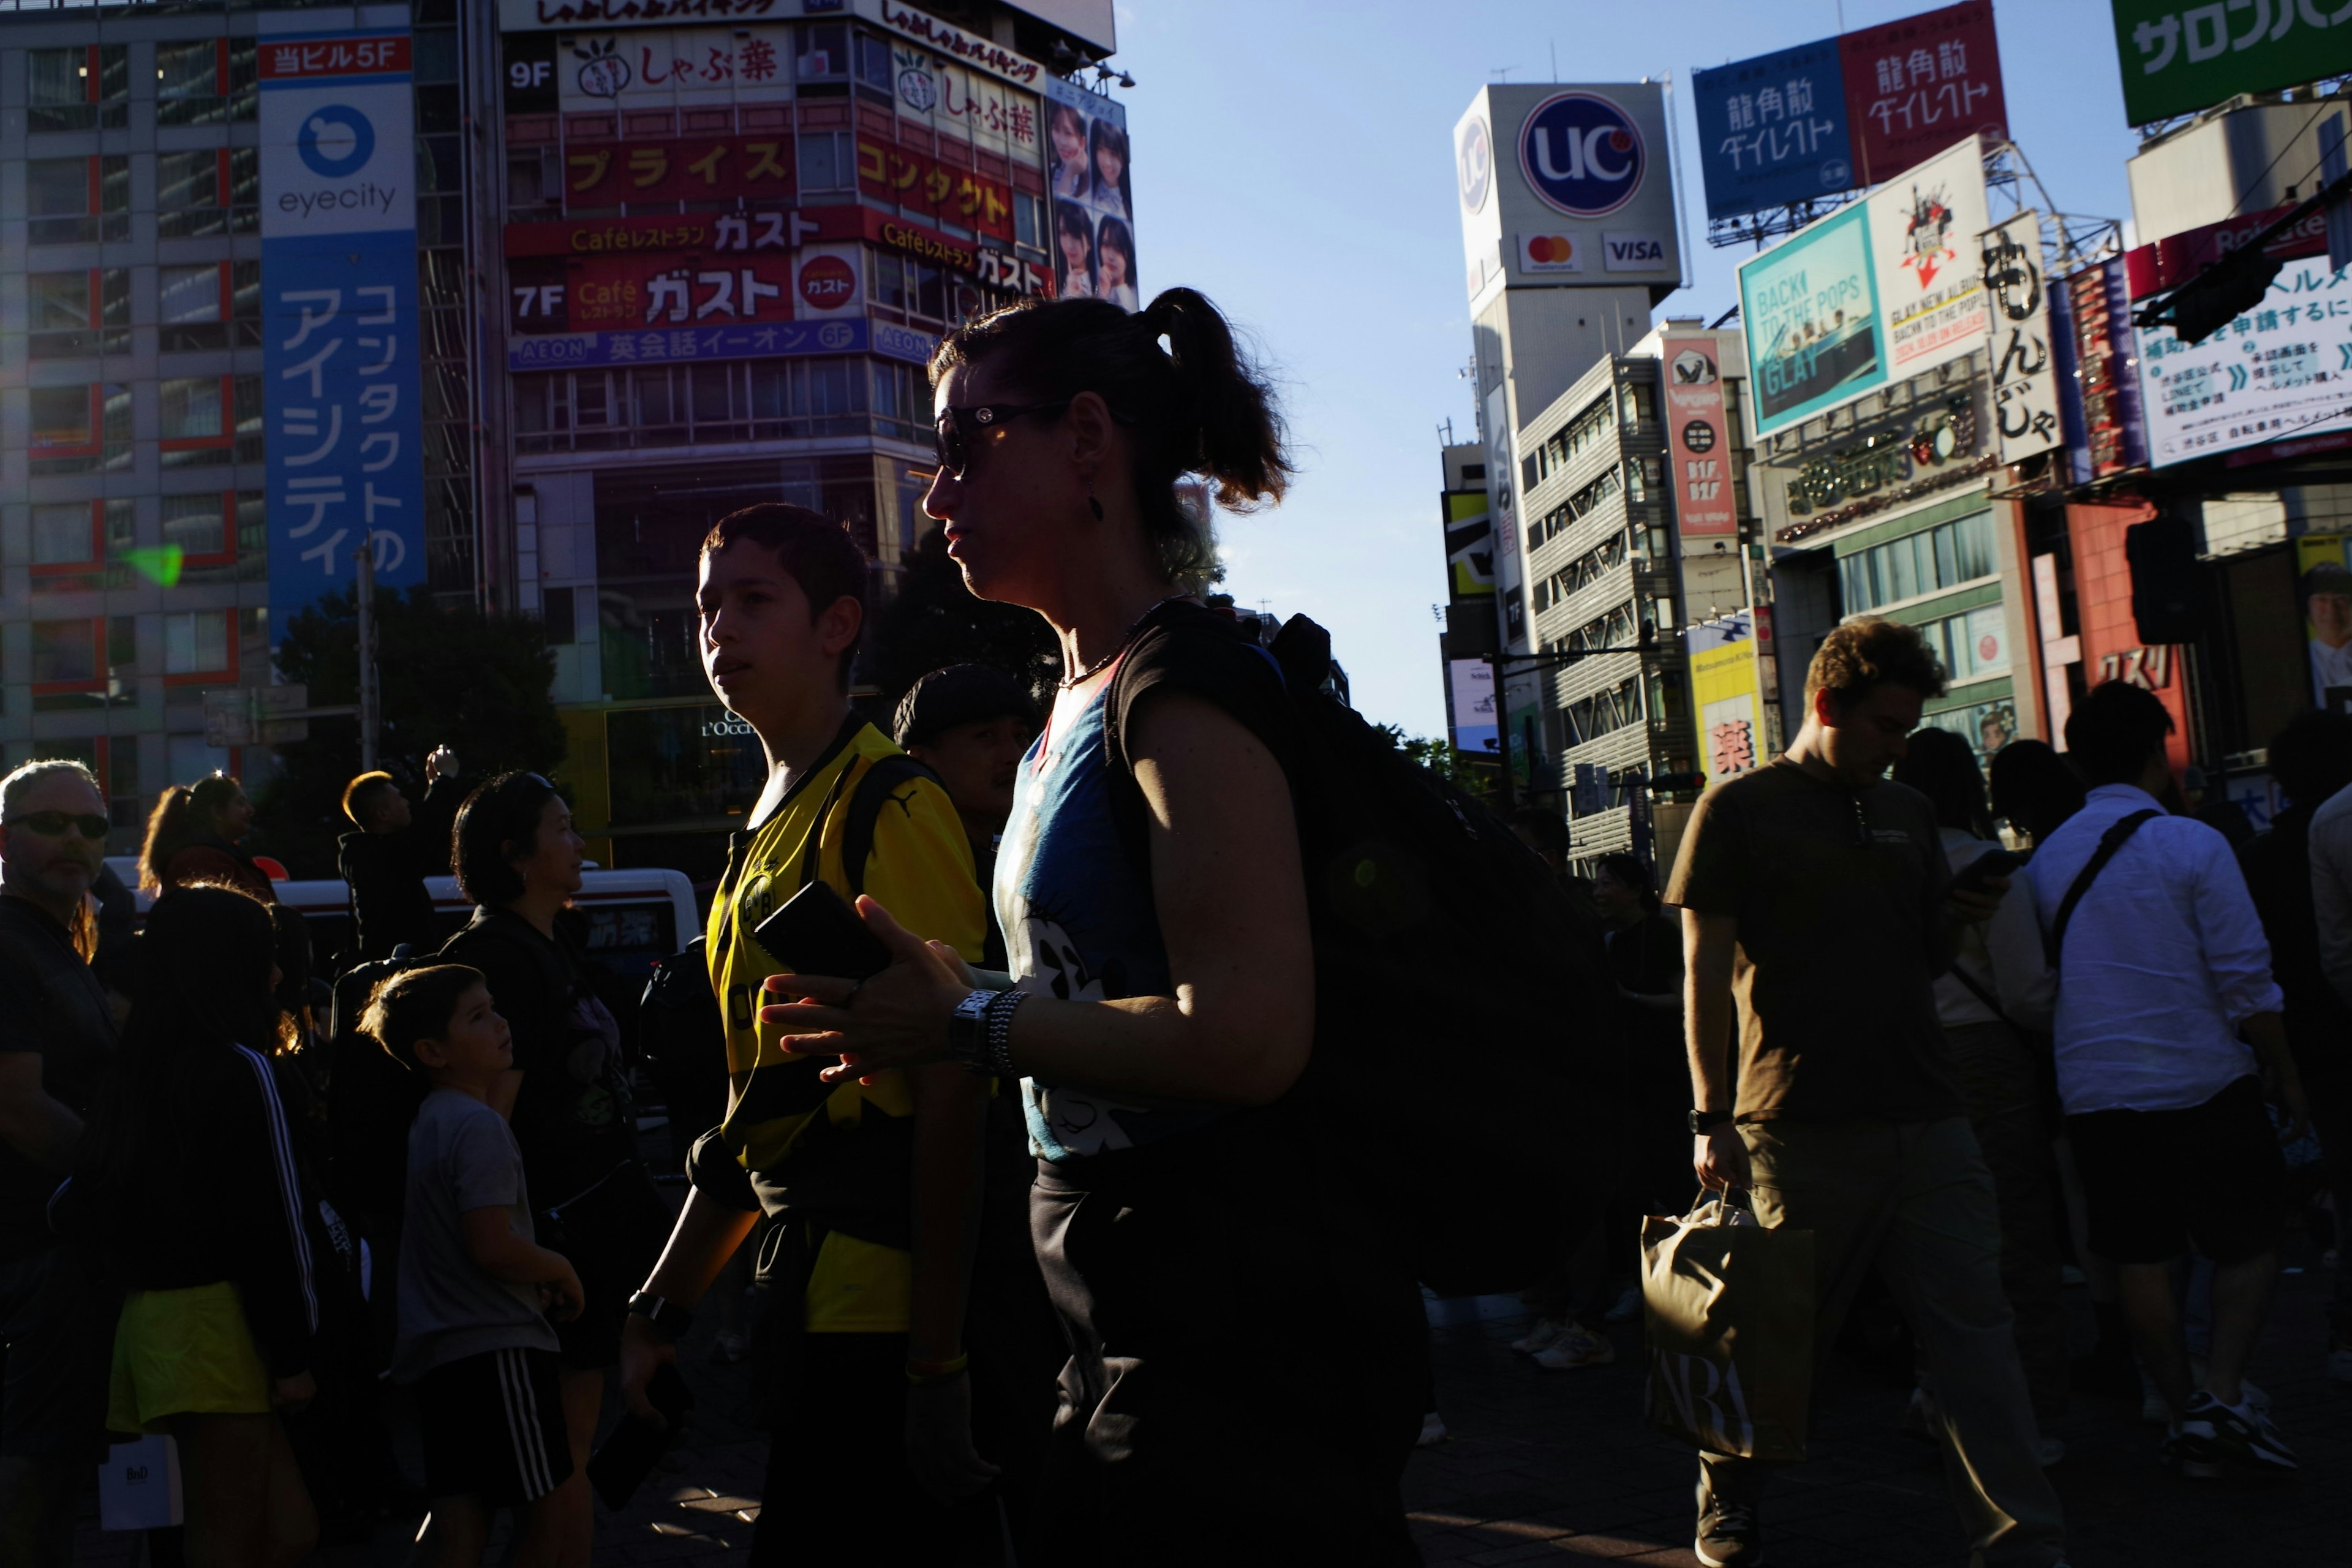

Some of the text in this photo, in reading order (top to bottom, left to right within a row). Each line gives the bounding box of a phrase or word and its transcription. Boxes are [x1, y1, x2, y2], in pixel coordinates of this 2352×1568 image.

[274, 41, 396, 74] 当ビル5F
[642, 39, 777, 85] しゃぶ葉
[882, 0, 1038, 83] しゃぶしゃぶバイキング
[510, 62, 551, 88] 9F
[1875, 39, 1969, 95] 龍角散
[945, 74, 1034, 143] しゃぶ葉
[1726, 77, 1815, 133] 龍角散
[568, 143, 786, 191] プライス
[858, 141, 1009, 225] コンタクト
[279, 183, 396, 219] eyecity
[714, 210, 820, 252] ガスト
[1608, 240, 1664, 261] VISA
[578, 279, 637, 304] Café
[807, 279, 850, 295] ガスト
[977, 249, 1044, 295] ガスト
[513, 285, 565, 317] 7F
[646, 270, 780, 324] ガスト
[1817, 274, 1861, 316] POPS
[520, 339, 585, 360] AEON
[609, 327, 807, 360] 英会話イーオン
[823, 326, 852, 345] 6F
[882, 325, 927, 354] AEON
[1765, 342, 1817, 396] GLAY
[280, 288, 349, 576] アイシティ
[356, 285, 405, 573] コンタクトの
[1713, 719, 1752, 774] 薬
